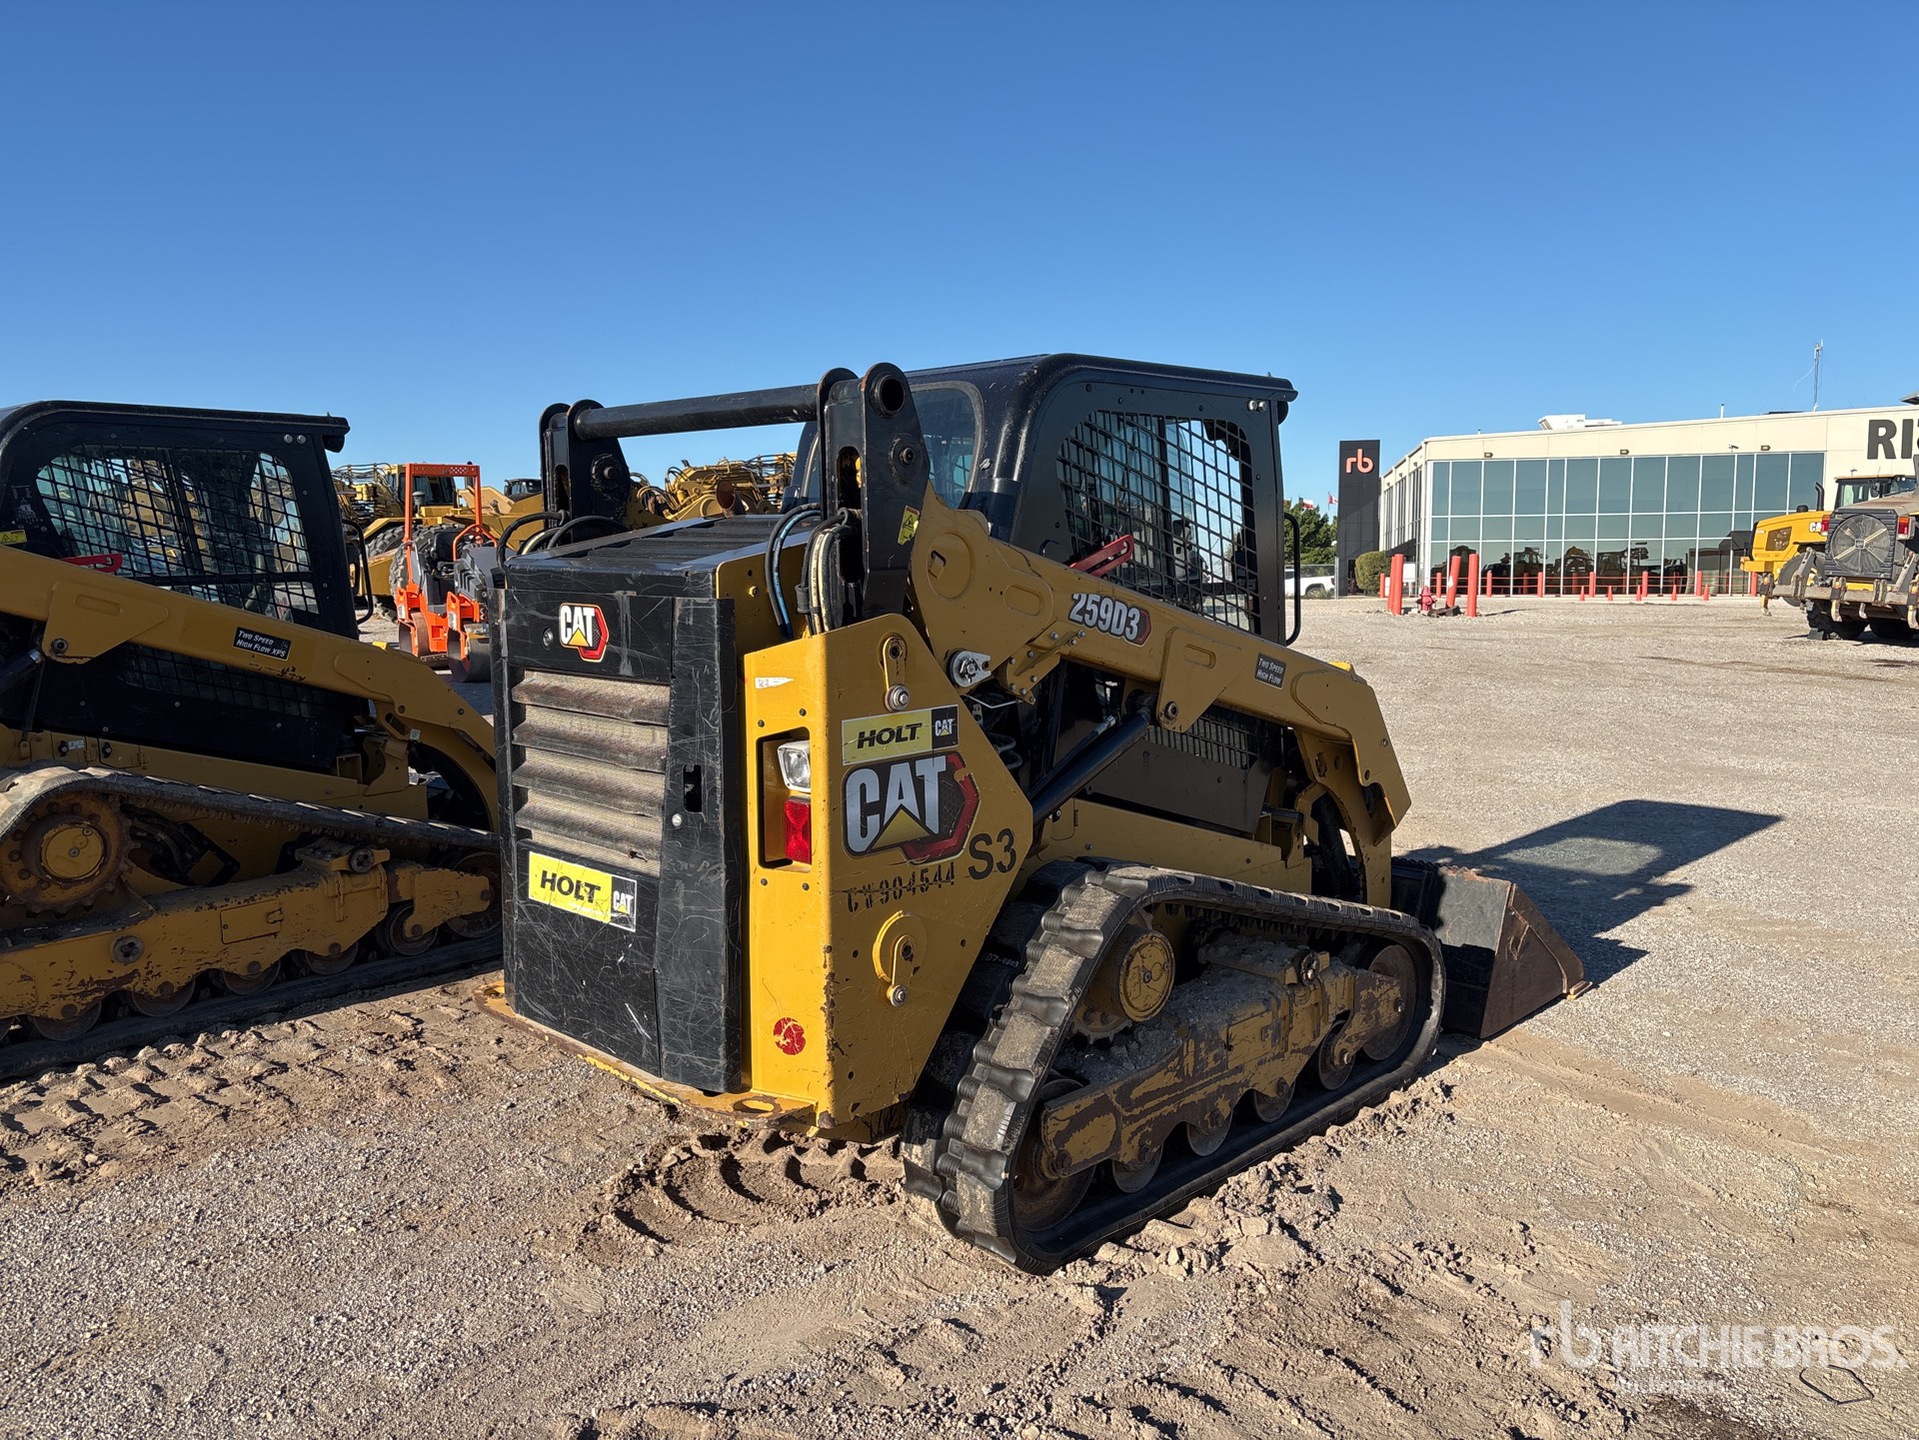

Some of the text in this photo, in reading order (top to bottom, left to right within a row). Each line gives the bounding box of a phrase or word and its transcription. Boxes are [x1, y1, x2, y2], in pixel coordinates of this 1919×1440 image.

[1867, 418, 1919, 460] RI
[1346, 448, 1374, 474] rb
[560, 605, 595, 648] CAT
[1069, 593, 1141, 641] 259D3
[271, 648, 287, 658] XPS
[857, 718, 953, 749] HOLT CAT
[845, 755, 947, 853] CAT
[968, 828, 1017, 880] S3
[540, 870, 634, 915] HOLT CAT
